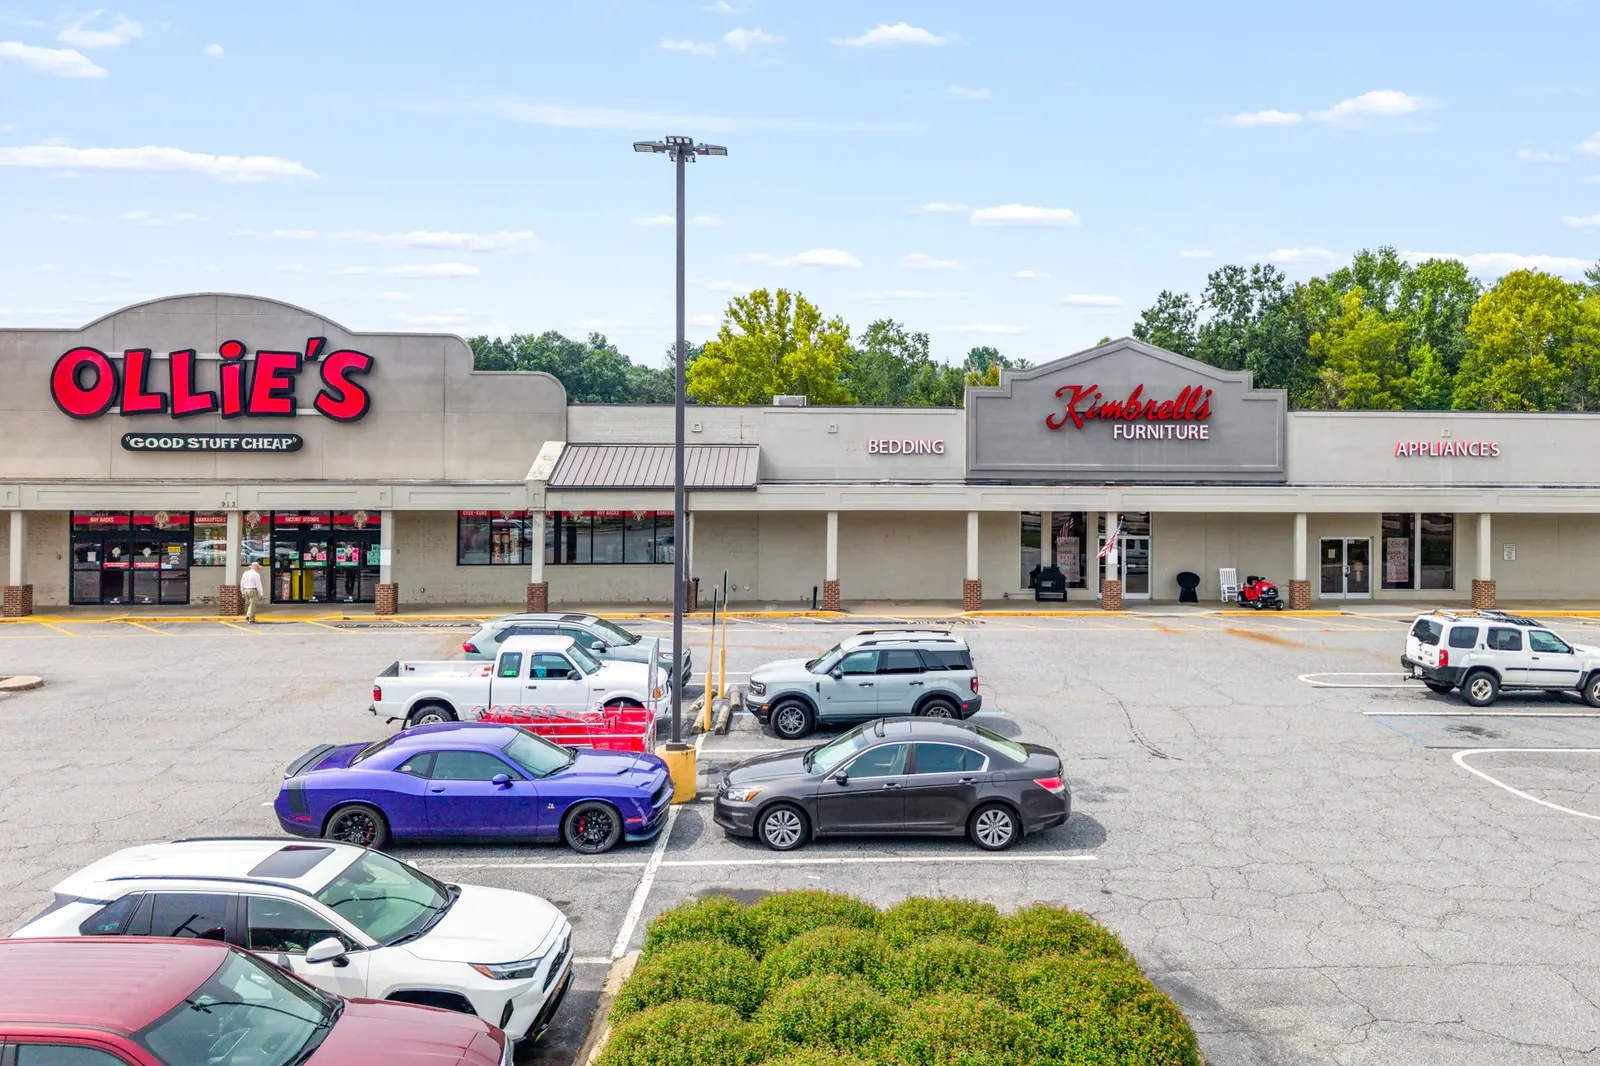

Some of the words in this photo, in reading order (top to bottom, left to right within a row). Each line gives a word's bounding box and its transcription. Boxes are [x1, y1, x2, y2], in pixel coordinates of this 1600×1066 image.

[1046, 383, 1213, 430] Kimbrell's
[1112, 424, 1209, 440] FURNITURE
[187, 437, 239, 449] STUFF
[867, 439, 945, 455] BEDDING
[1394, 440, 1501, 457] APPLIANCES
